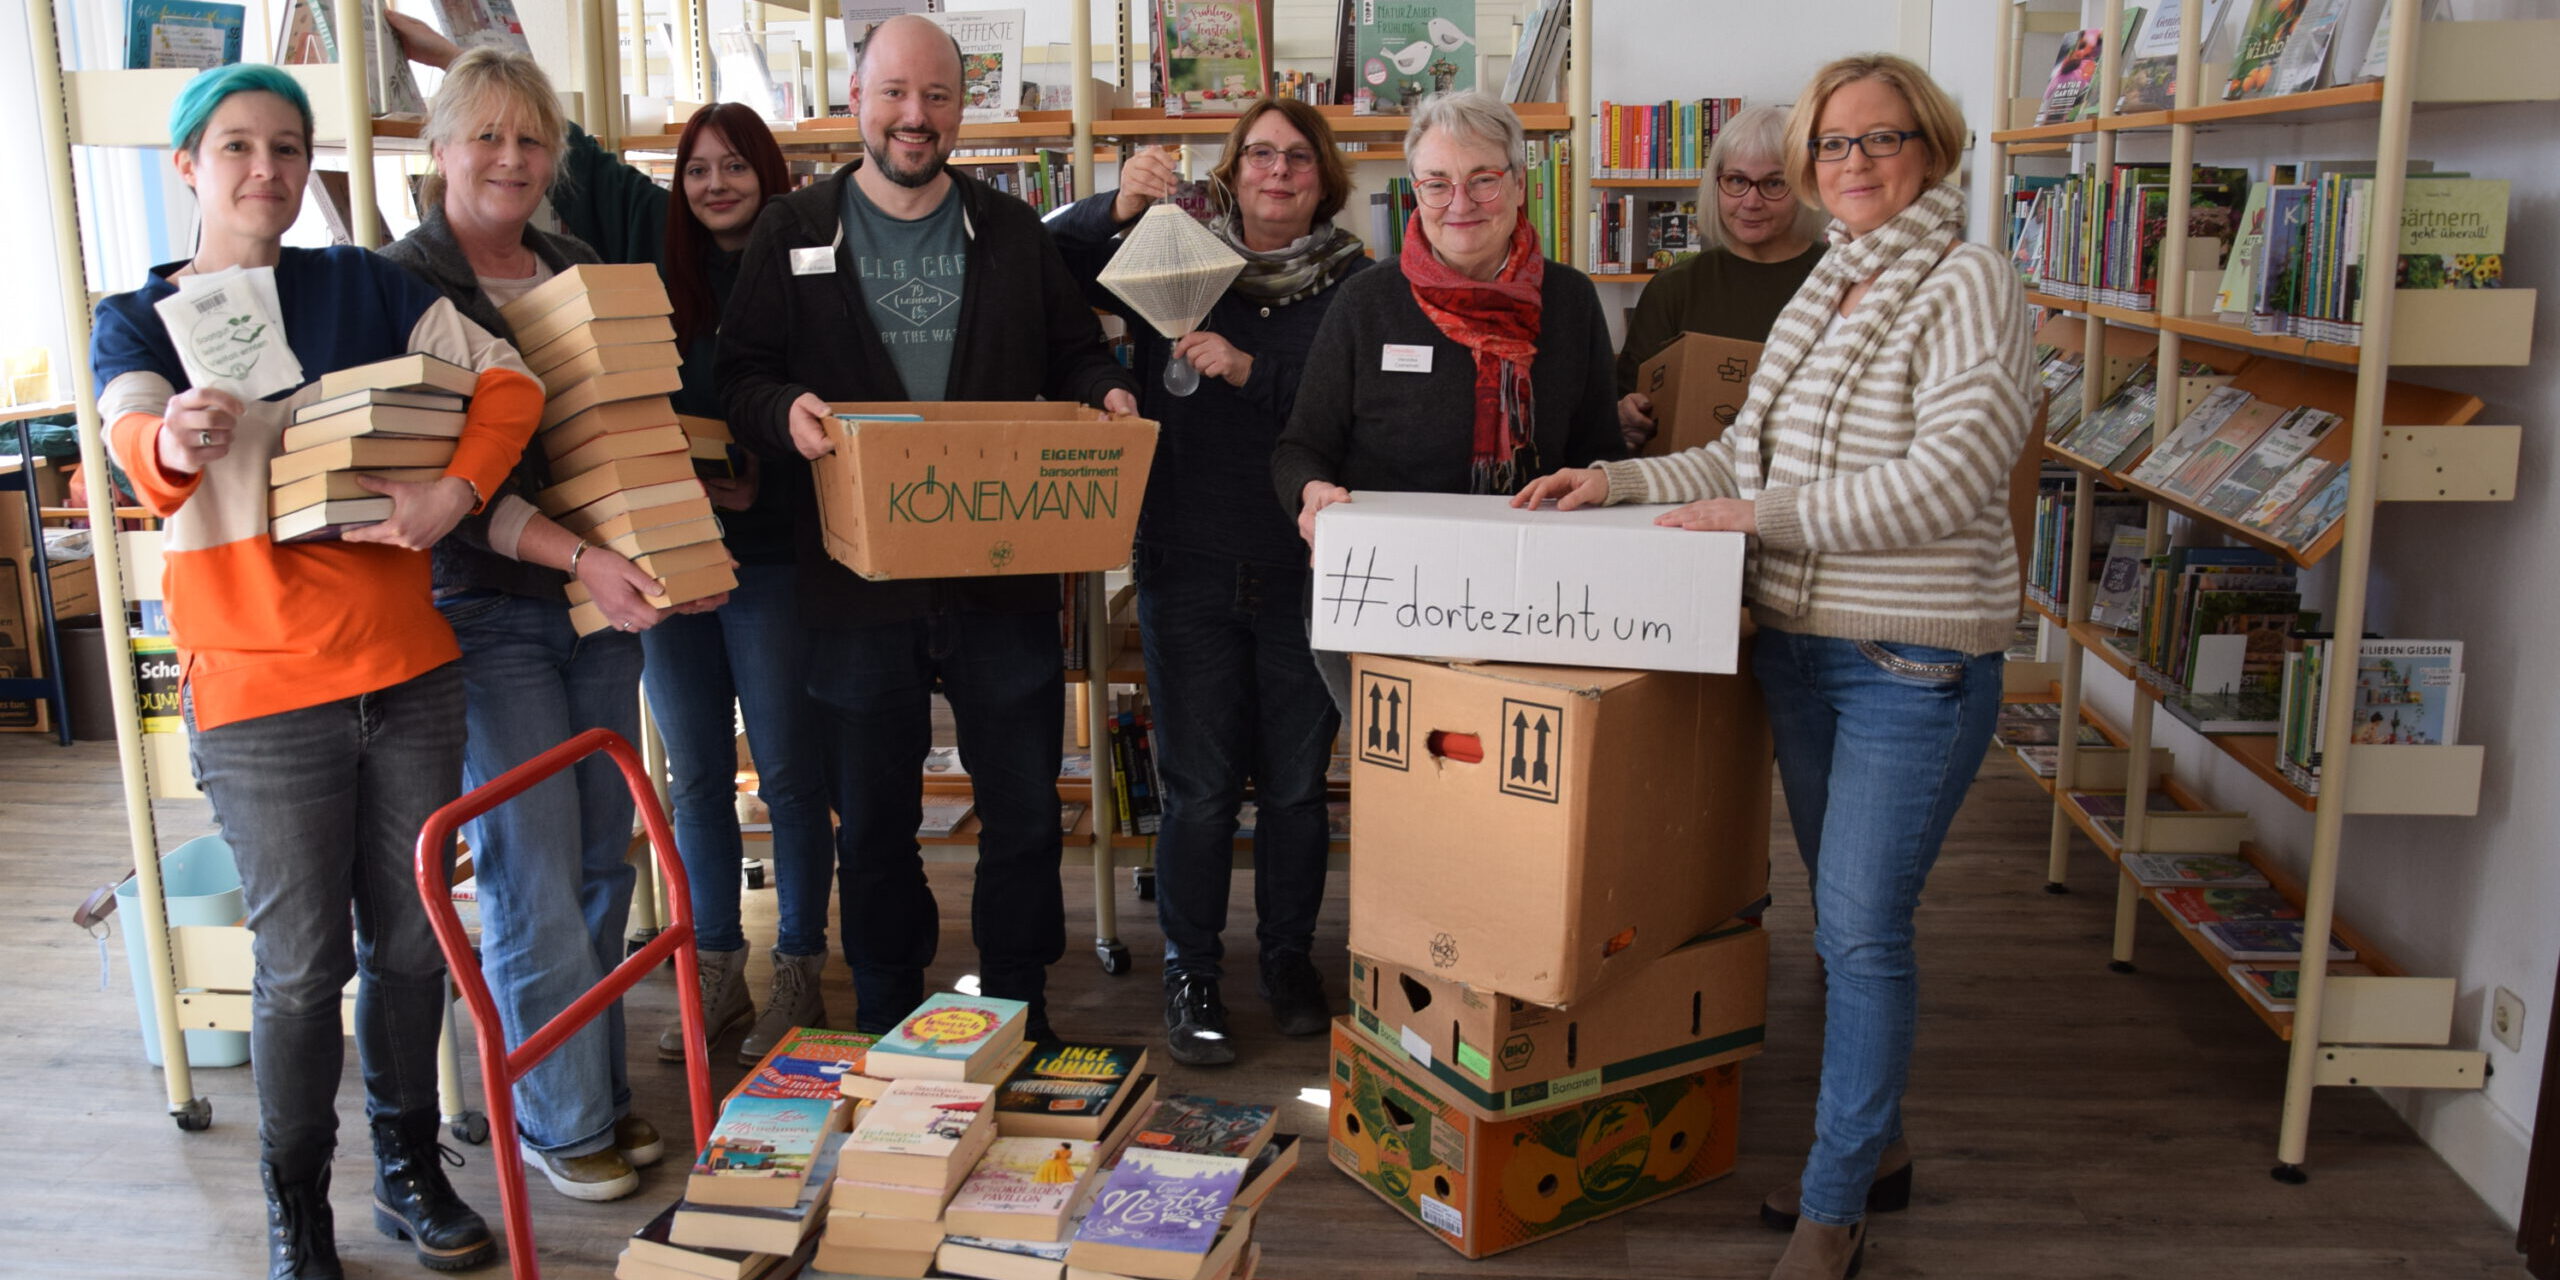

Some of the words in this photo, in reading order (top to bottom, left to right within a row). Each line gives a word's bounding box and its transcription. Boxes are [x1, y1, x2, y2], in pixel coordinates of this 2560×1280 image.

[2410, 226, 2436, 246] geht
[903, 330, 928, 343] THE
[1041, 448, 1121, 461] EIGENTUM
[1040, 465, 1119, 478] barsortiment
[888, 465, 1118, 523] KÖNEMANN
[1613, 615, 1672, 644] um
[2369, 646, 2403, 655] LIEBEN
[2407, 646, 2452, 655] GIESSEN
[1060, 1046, 1113, 1060] INGE
[1505, 1042, 1529, 1058] BIO
[1009, 1080, 1110, 1097] UNBARMHERZIG
[1552, 1076, 1598, 1095] Bananen
